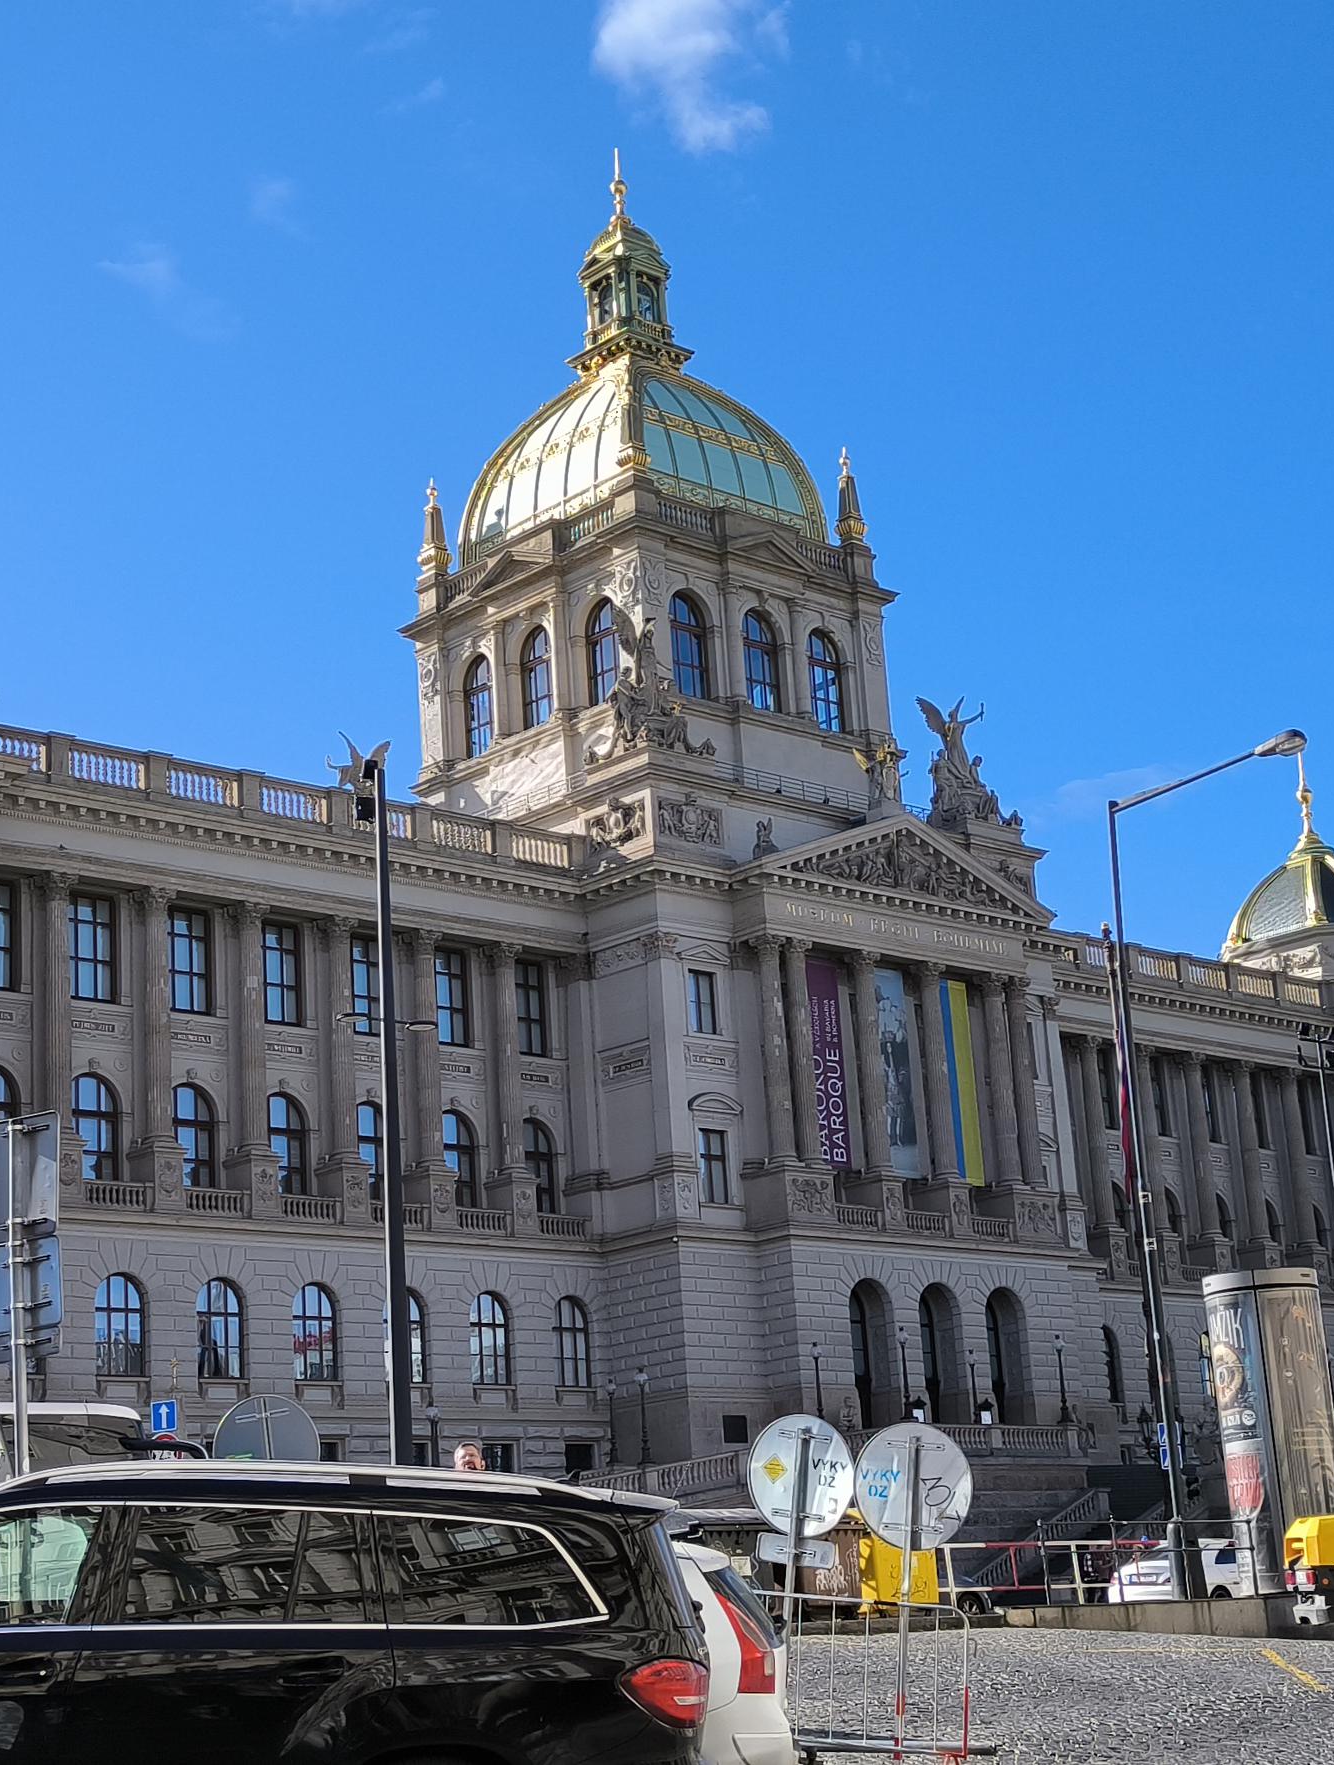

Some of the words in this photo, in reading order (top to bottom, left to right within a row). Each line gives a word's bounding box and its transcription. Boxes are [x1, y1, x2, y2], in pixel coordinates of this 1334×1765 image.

[825, 1048, 847, 1163] BAROQUE
[811, 1458, 849, 1473] VYKY
[860, 1468, 901, 1483] VYKY
